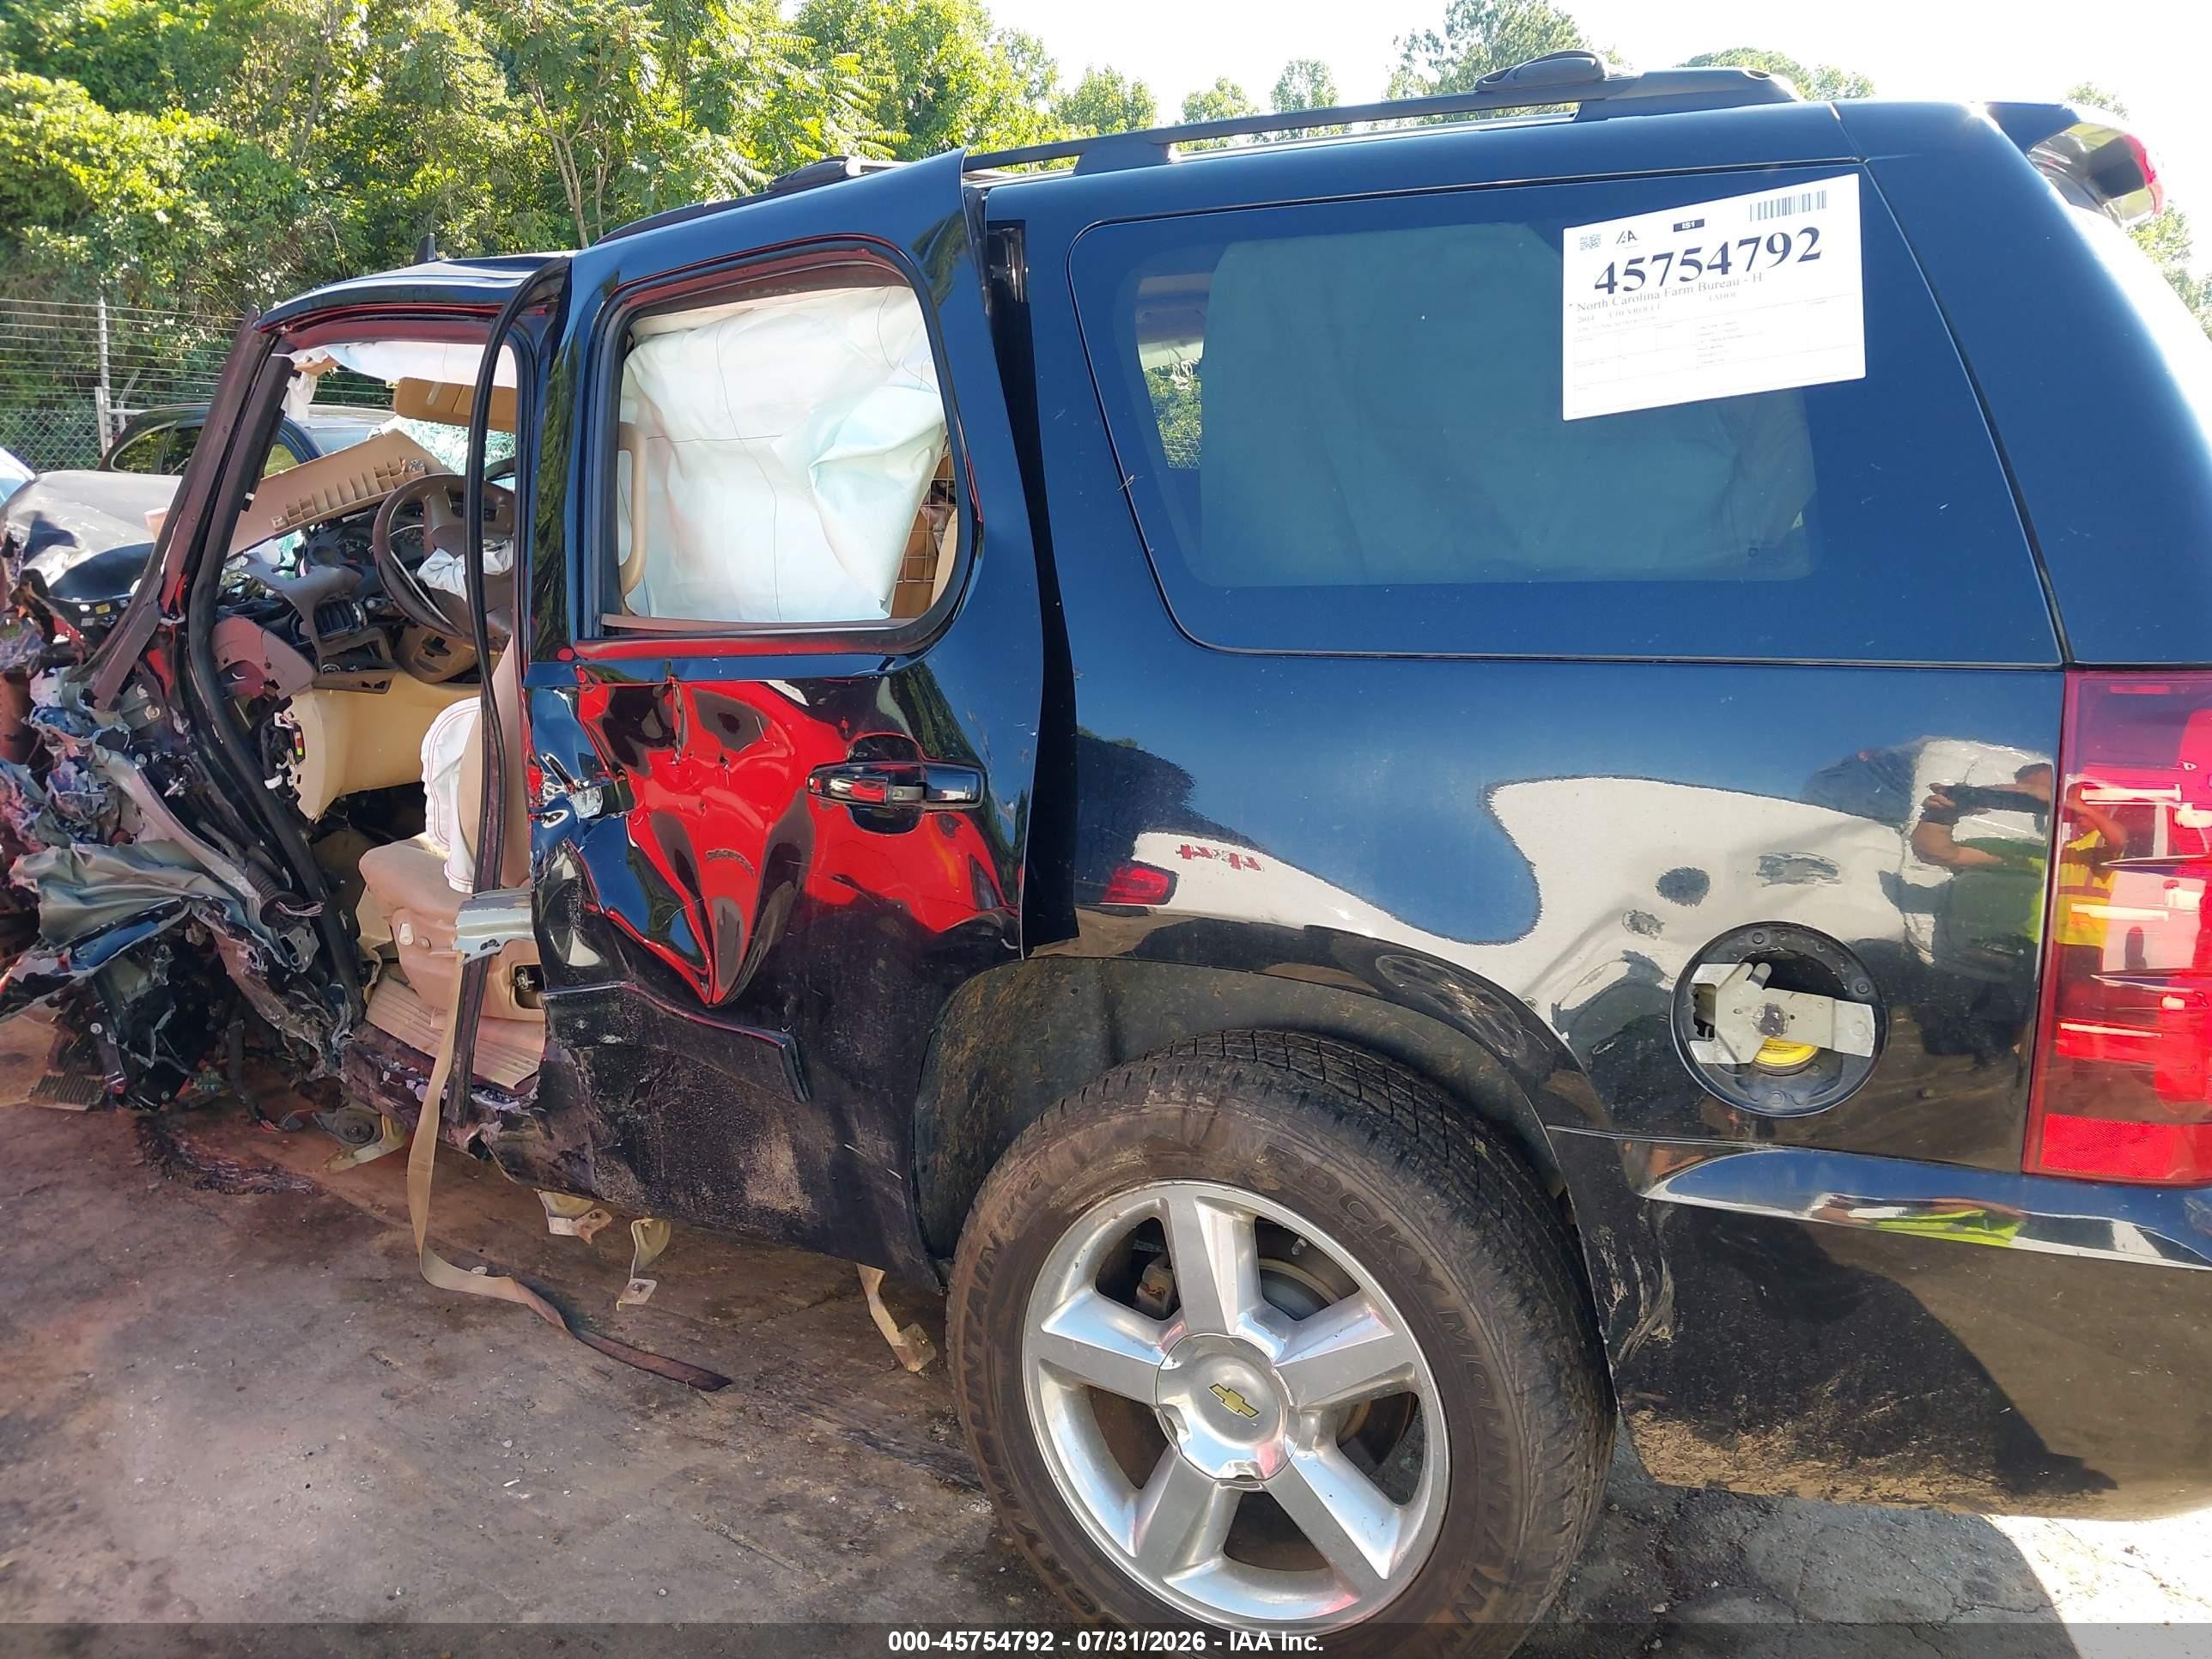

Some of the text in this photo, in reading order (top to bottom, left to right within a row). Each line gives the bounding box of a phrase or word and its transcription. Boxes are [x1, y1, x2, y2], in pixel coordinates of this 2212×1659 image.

[1595, 226, 1822, 295] 45754792
[1577, 297, 1607, 312] North
[1612, 289, 1659, 306] Carolina
[1664, 283, 1692, 297] Farm
[1698, 275, 1739, 292] Bureau
